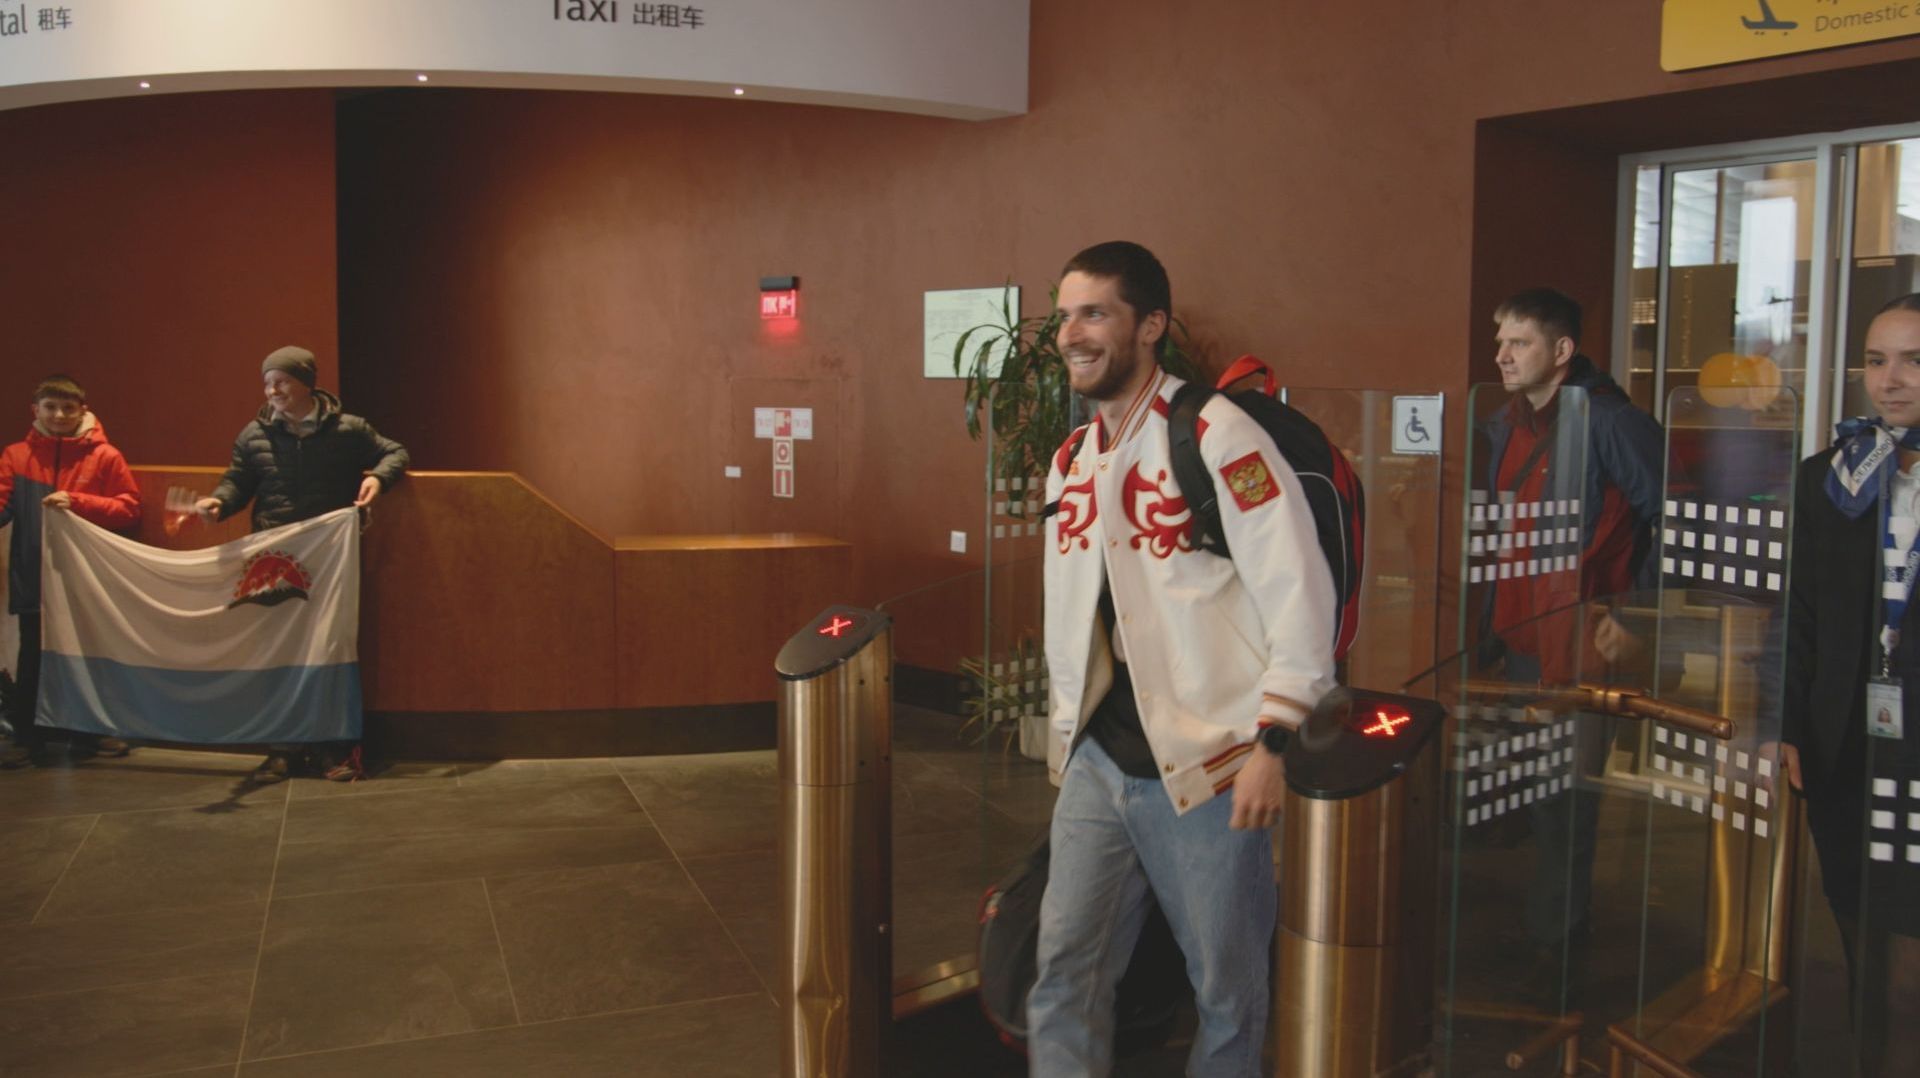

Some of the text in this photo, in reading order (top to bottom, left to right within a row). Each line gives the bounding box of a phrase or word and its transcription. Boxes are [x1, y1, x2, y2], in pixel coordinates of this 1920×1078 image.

[38, 6, 72, 31] 租车
[633, 2, 705, 29] 出租车
[1814, 2, 1910, 32] Domestic
